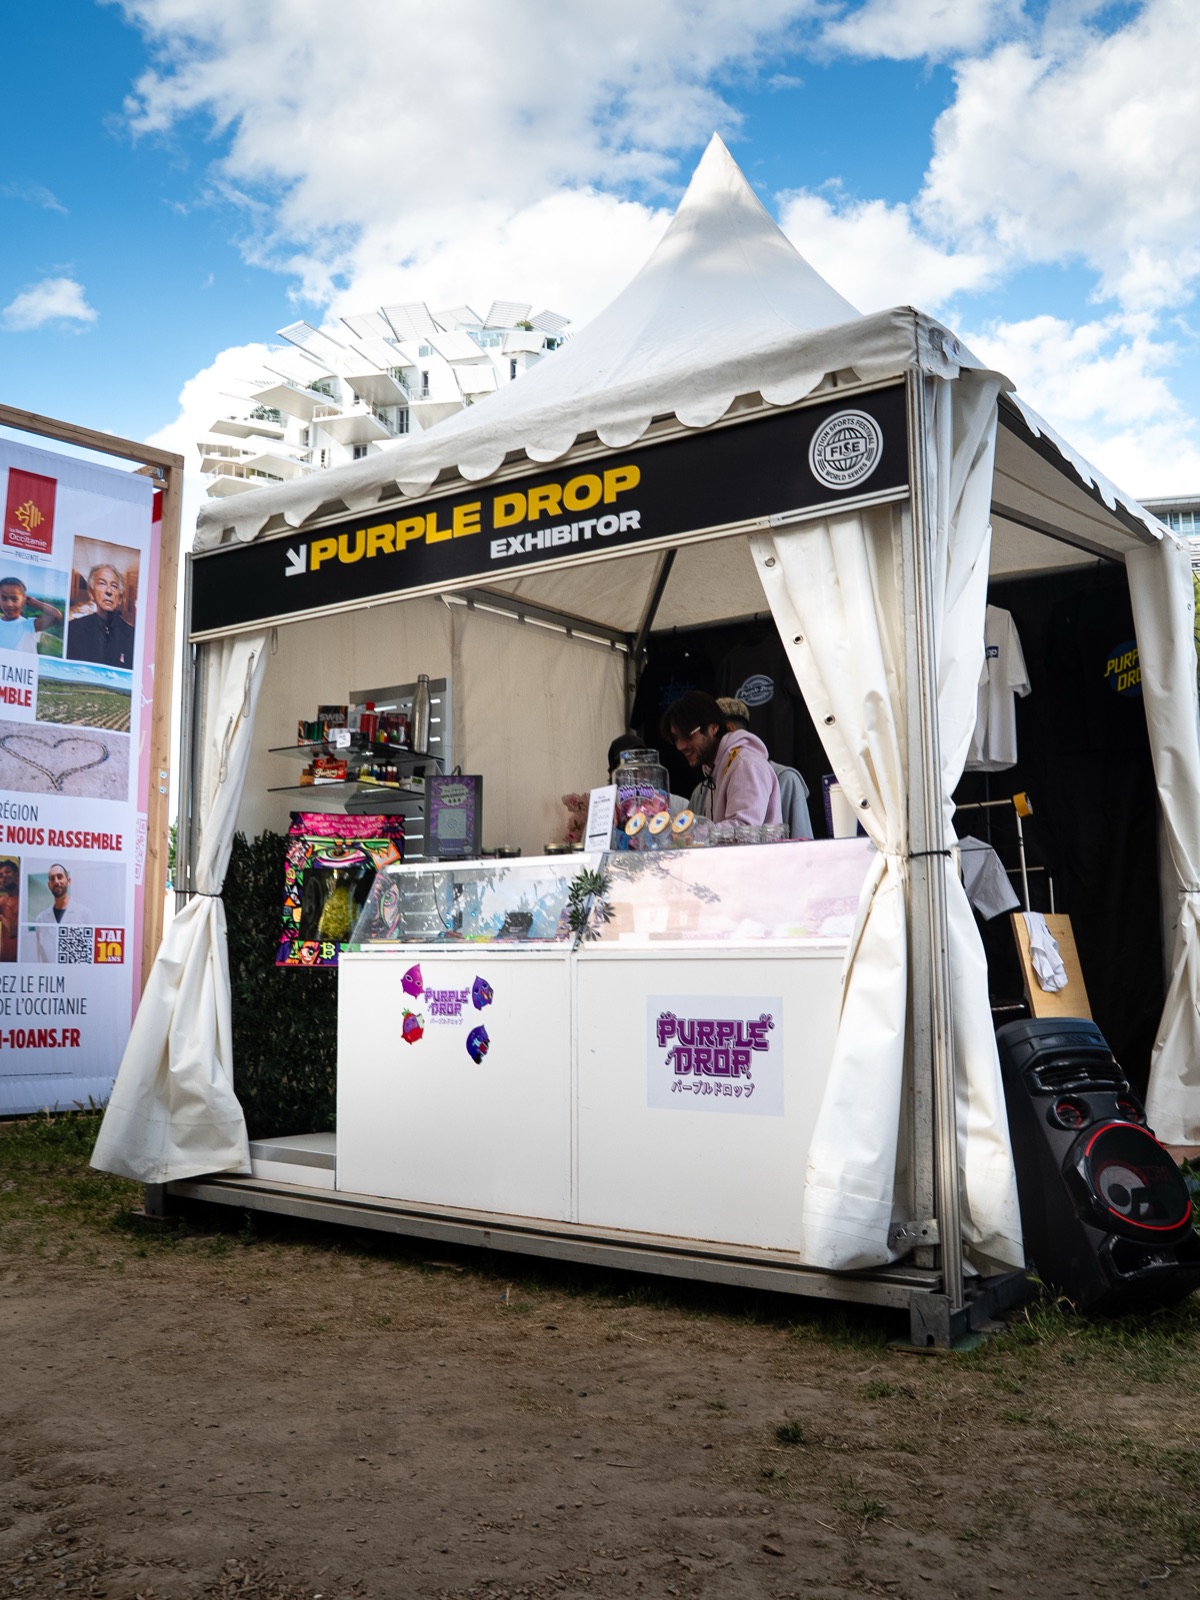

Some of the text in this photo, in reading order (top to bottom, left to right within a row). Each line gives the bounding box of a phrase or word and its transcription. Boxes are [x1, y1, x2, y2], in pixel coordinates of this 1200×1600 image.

[828, 418, 855, 433] SPORTS
[830, 441, 861, 458] FISE
[825, 463, 868, 481] WORLD SERIES
[310, 465, 641, 571] PURPLE DROP
[8, 532, 47, 547] Occitanie
[490, 509, 642, 560] EXHIBITOR
[6, 825, 45, 846] NOUS
[48, 829, 123, 851] RASSEMBLE
[97, 942, 122, 962] 10
[0, 975, 65, 993] EZ LE FILM
[424, 987, 470, 1004] PURPLE
[16, 997, 87, 1015] L'OCCITANIE
[427, 1002, 462, 1017] DROP
[656, 1011, 775, 1052] PURPLE
[665, 1045, 752, 1080] DROP
[671, 1079, 756, 1098] パープルドロップ
